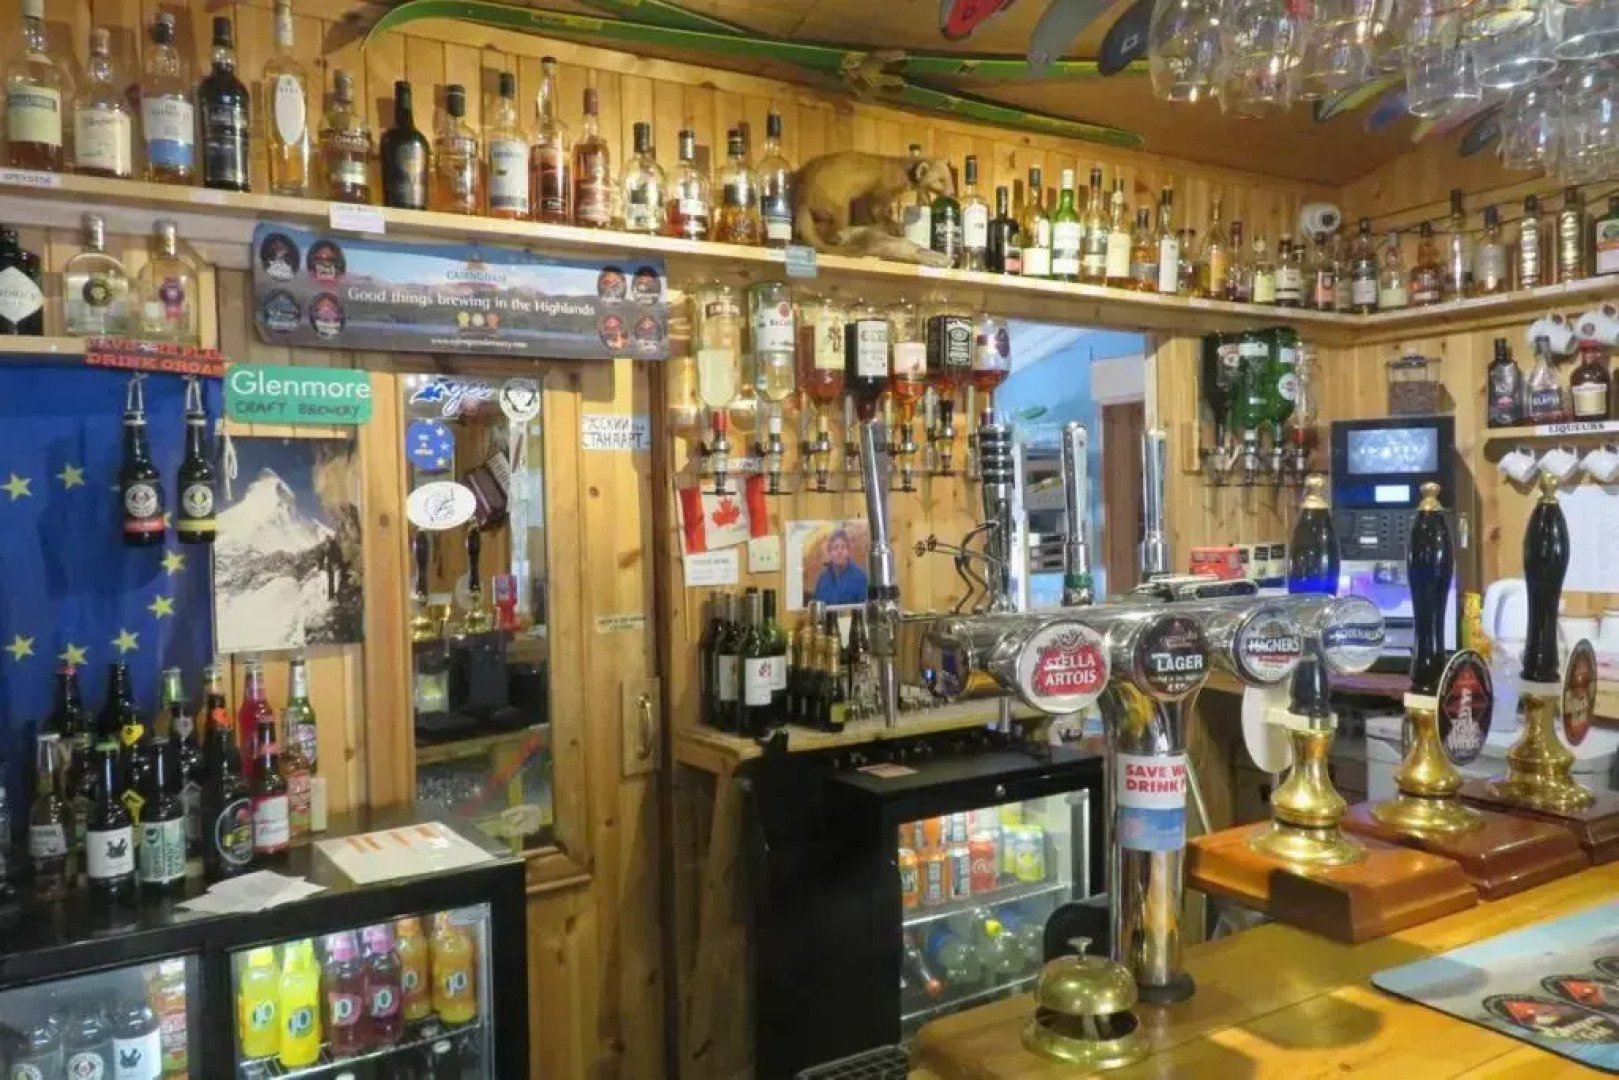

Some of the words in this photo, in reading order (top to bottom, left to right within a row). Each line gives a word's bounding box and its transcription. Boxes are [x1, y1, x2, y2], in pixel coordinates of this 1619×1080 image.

[347, 288, 387, 303] Good
[392, 290, 434, 308] things
[437, 292, 491, 311] brewing
[494, 296, 507, 309] in
[510, 298, 532, 312] the
[534, 300, 597, 317] Highlands
[231, 369, 371, 399] Glenmore
[235, 400, 288, 416] CRAFT
[298, 402, 361, 418] BREWERY
[1549, 422, 1605, 433] LIQUEURS
[1247, 637, 1300, 653] MAGNERS
[1045, 652, 1096, 671] STELLA
[1156, 654, 1203, 673] LAGER
[1045, 669, 1097, 687] ARTOIS
[1125, 763, 1167, 779] SAVE
[1126, 778, 1179, 793] DRINK
